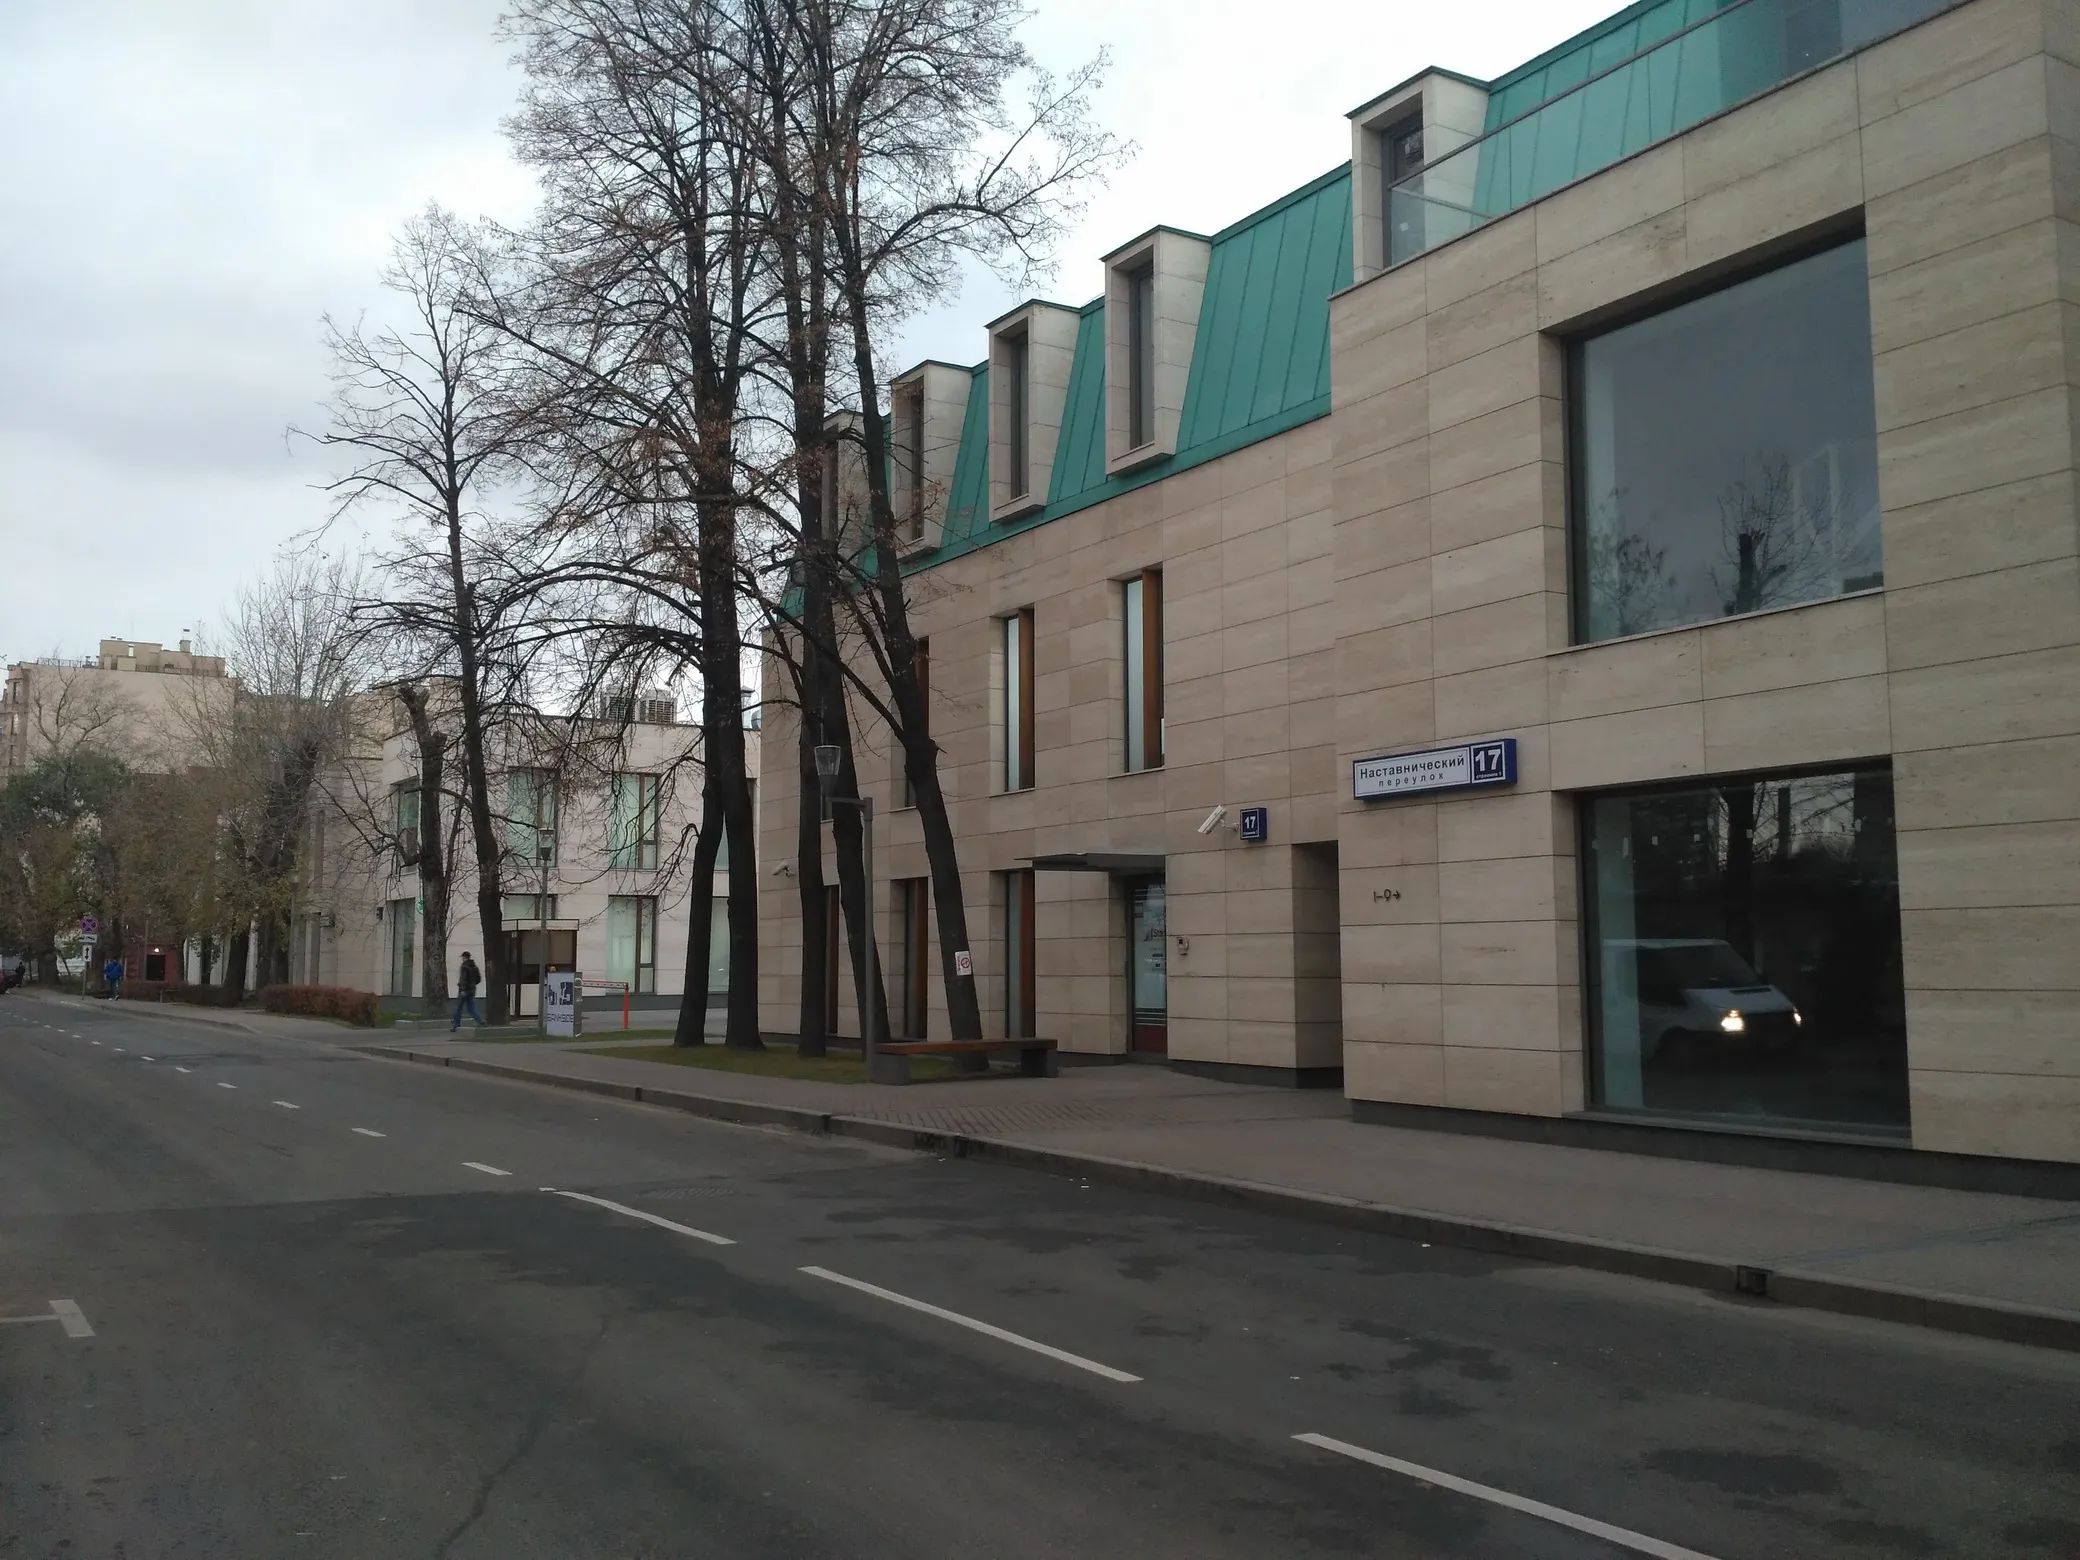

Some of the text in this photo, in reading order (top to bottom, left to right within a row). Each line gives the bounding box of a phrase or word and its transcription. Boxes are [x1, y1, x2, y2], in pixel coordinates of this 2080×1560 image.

[1360, 756, 1465, 779] Наставнический
[1475, 749, 1501, 772] 17
[1379, 772, 1444, 788] переулок
[1244, 816, 1256, 829] 17
